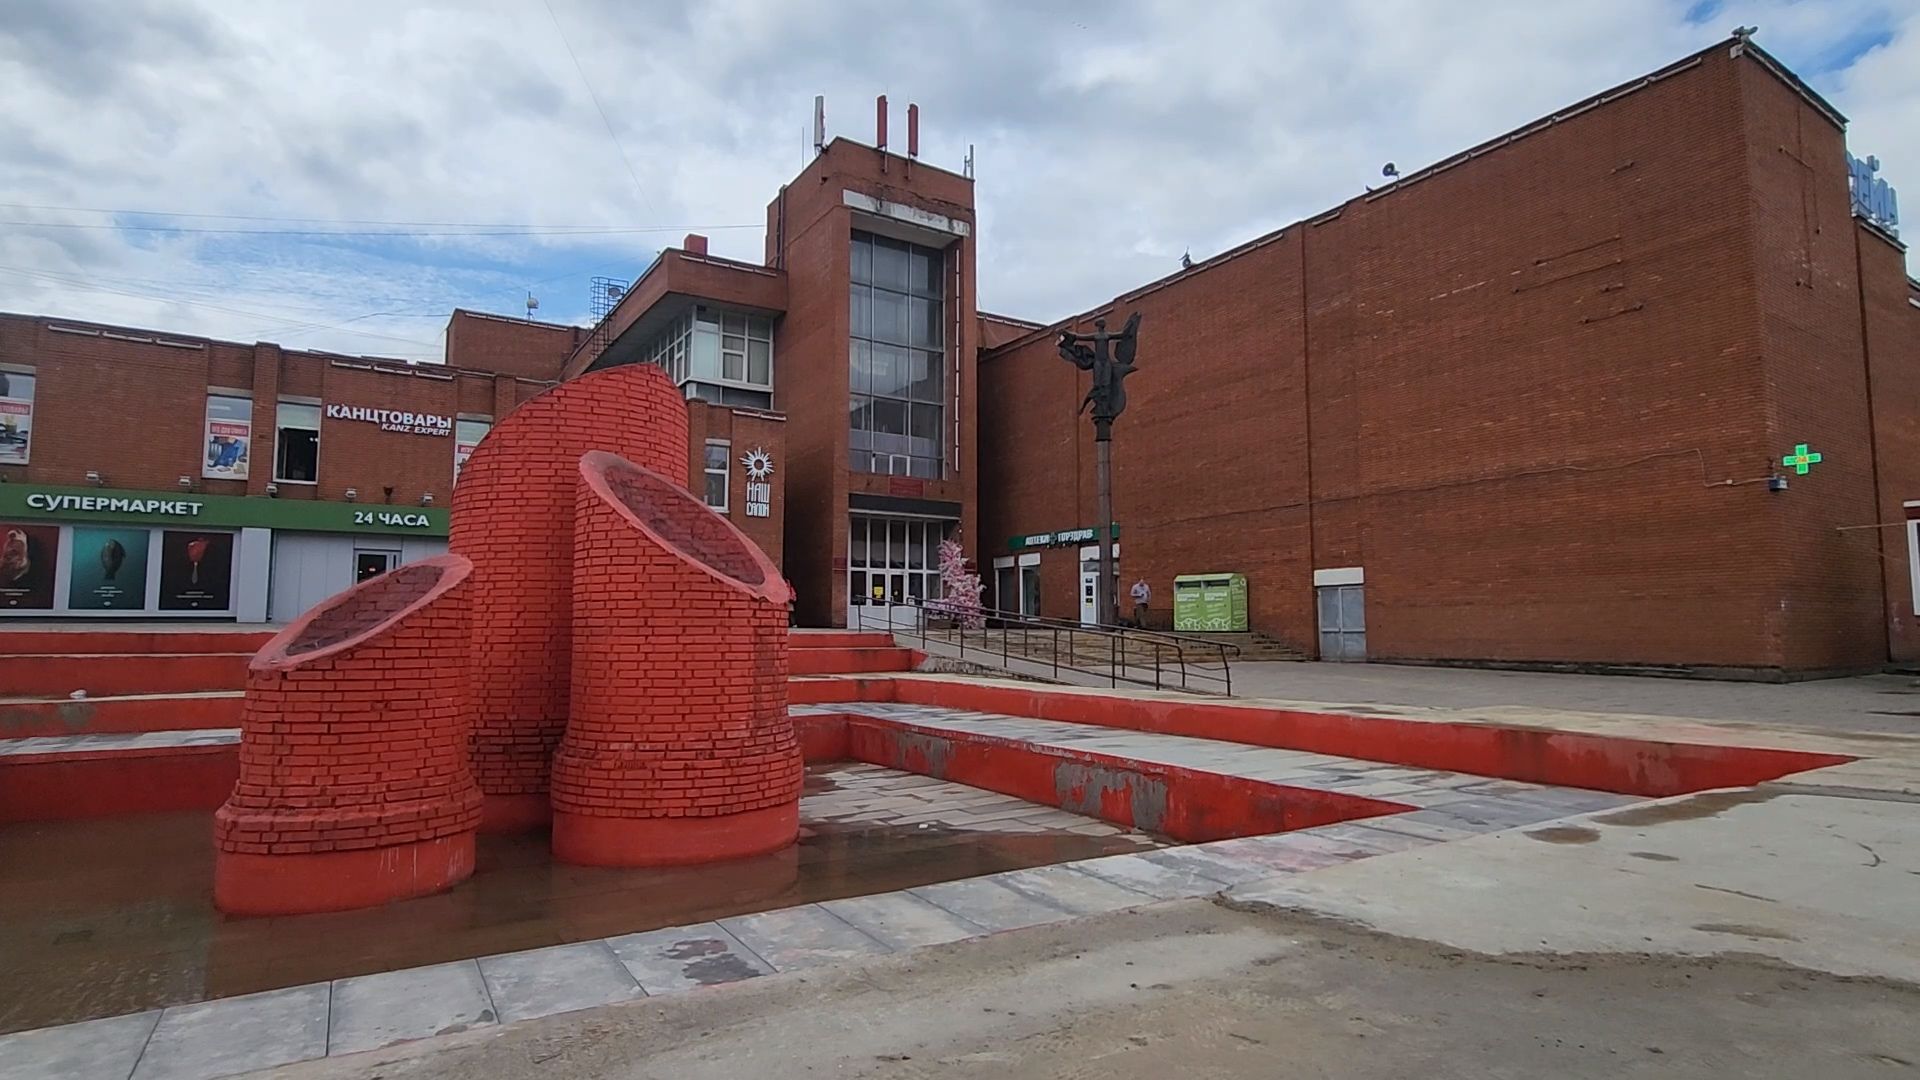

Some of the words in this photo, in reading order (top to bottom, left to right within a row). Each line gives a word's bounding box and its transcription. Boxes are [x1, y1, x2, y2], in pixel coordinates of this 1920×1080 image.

[326, 404, 452, 428] КАНЦТОВАРЫ
[381, 423, 411, 433] KANZ
[414, 426, 450, 437] EXPERT
[746, 481, 770, 503] НАШ
[26, 494, 203, 515] СУПЕРМАРКЕТ
[354, 511, 373, 524] 24
[378, 512, 430, 527] ЧАСА
[1057, 529, 1094, 543] ГОРЗДРАВ
